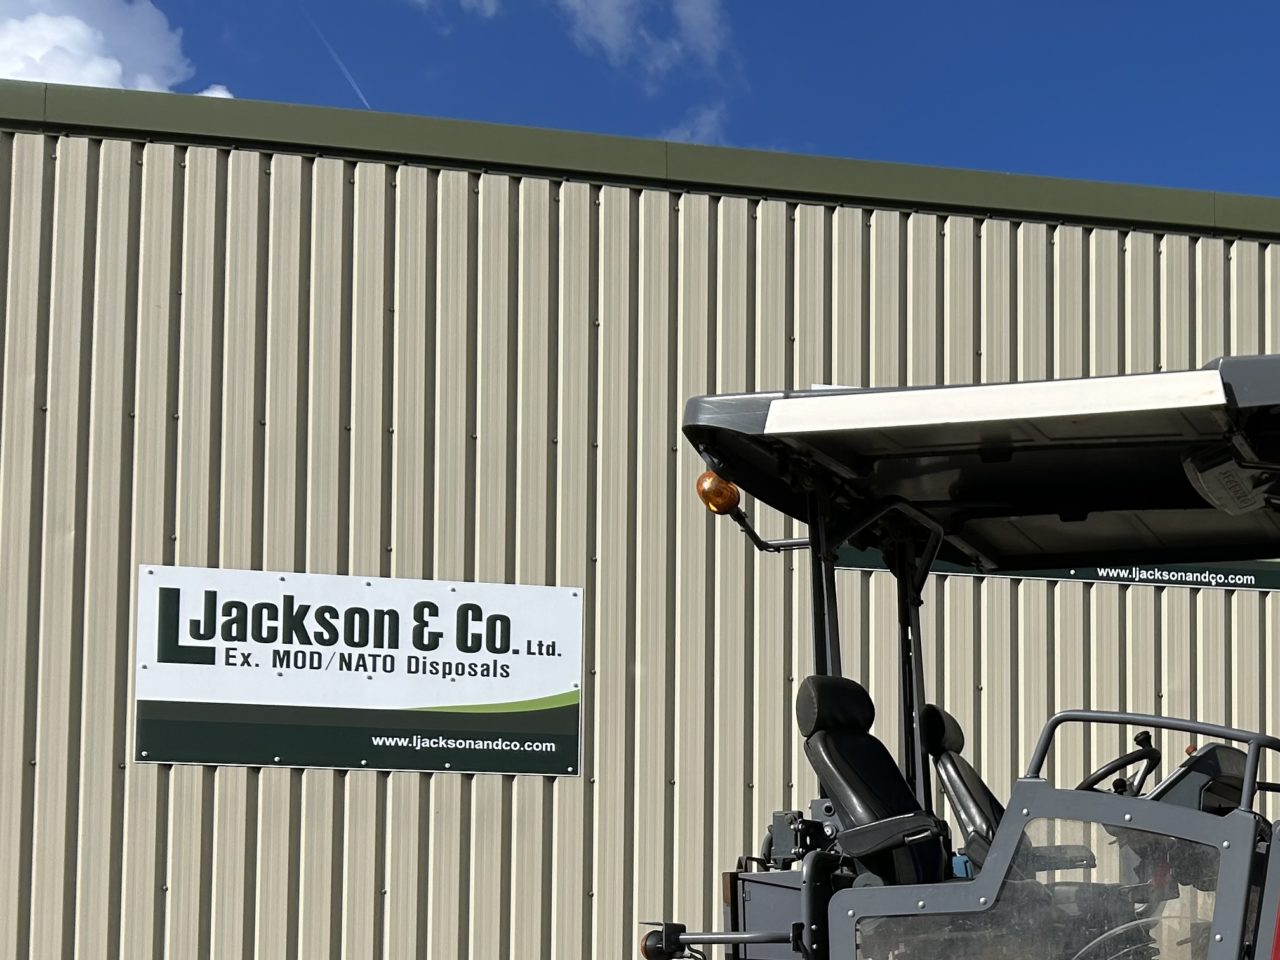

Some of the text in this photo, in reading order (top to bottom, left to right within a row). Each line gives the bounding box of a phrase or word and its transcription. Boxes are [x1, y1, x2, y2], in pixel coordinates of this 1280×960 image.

[1097, 566, 1256, 585] www.ljacksonandco.com
[412, 600, 444, 652] &
[455, 603, 520, 656] Co.
[526, 640, 563, 658] Ltd.
[224, 647, 511, 680] Ex. MOD/NATO Disposals
[371, 734, 557, 753] www.ljacksonandco.com
